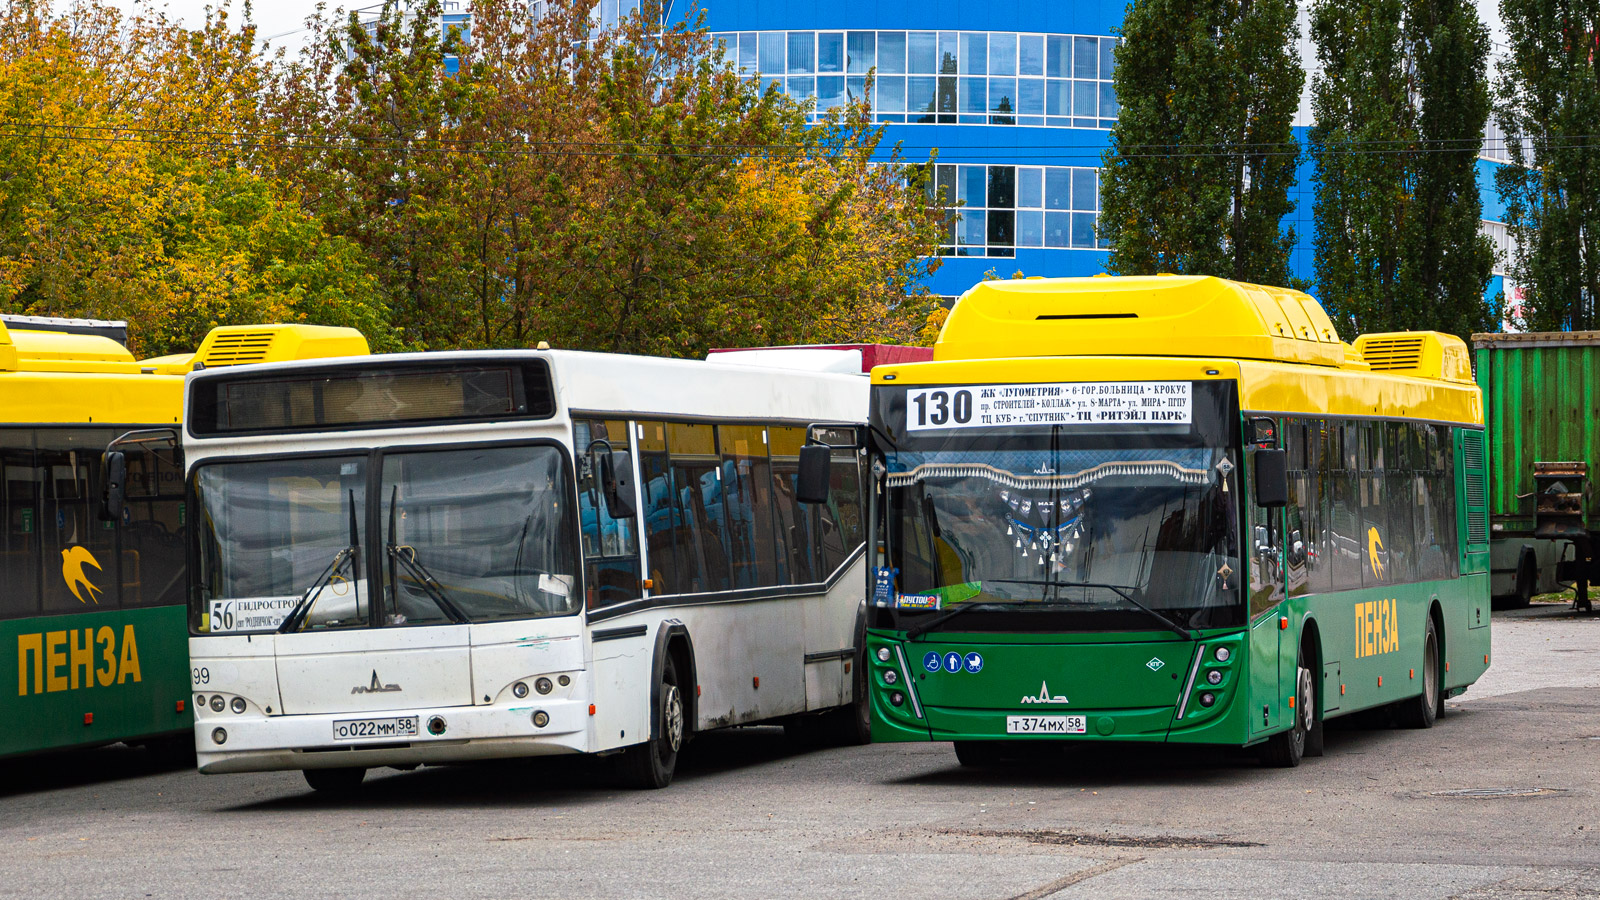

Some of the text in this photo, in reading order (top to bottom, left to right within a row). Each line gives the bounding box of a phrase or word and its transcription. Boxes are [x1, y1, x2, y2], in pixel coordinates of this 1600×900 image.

[981, 388, 996, 398] ЖК
[1154, 385, 1187, 395] КРОКУС
[912, 390, 973, 426] 130
[993, 398, 1035, 409] СТРОИТЕЛЕЙ
[1041, 399, 1071, 408] КОЛЛАЖ
[1141, 398, 1161, 407] МИРА
[1168, 398, 1187, 407] ПГПУ
[981, 414, 992, 424] ТЦ
[996, 413, 1012, 423] КУБ
[1077, 411, 1092, 422] ТЦ
[1096, 409, 1146, 420] «РИТЭЙЛ
[1151, 410, 1187, 420] ПАРК»
[212, 601, 234, 631] 56
[1355, 598, 1399, 659] ПЕНЗА
[18, 624, 142, 696] ПЕНЗА
[191, 667, 210, 685] 99
[398, 719, 412, 730] 58
[1068, 718, 1081, 728] 58
